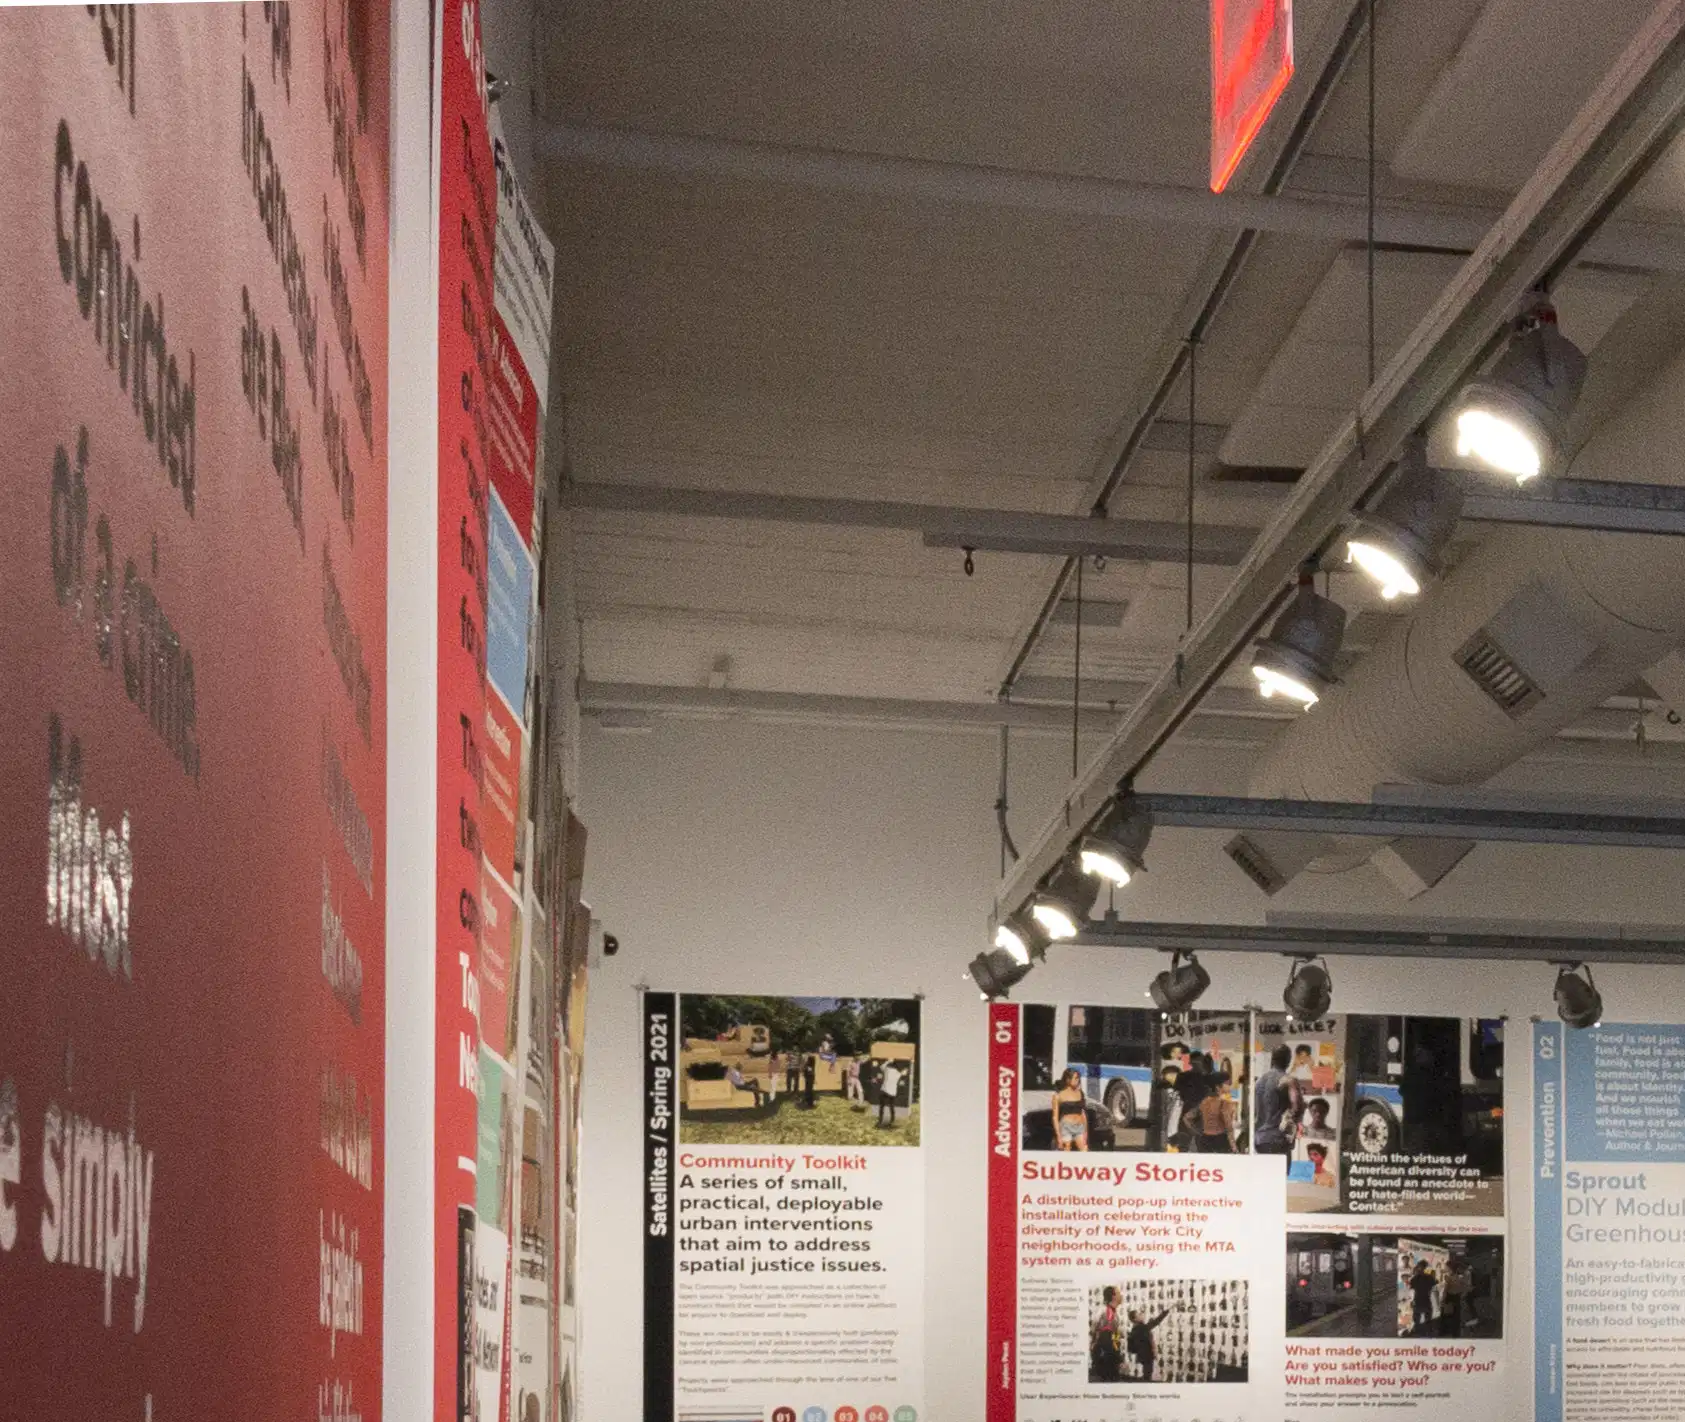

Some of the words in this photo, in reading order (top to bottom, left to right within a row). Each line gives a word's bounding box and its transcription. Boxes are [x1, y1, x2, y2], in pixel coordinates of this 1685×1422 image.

[54, 118, 196, 518] convicted
[51, 424, 89, 618] of
[96, 512, 113, 668] a
[121, 531, 200, 783] crime.
[47, 712, 133, 979] Most
[651, 1014, 667, 1062] 2021
[996, 1021, 1011, 1043] 01
[1539, 1034, 1554, 1059] 02
[651, 1066, 672, 1130] Spring
[995, 1065, 1015, 1158] Advocacy
[650, 1133, 668, 1144] /
[1539, 1081, 1554, 1177] Prevention
[680, 1153, 796, 1172] Community
[800, 1154, 869, 1170] Toolkit
[1022, 1160, 1128, 1185] Subway
[1134, 1162, 1226, 1182] Stories
[41, 1040, 154, 1331] simply
[651, 1146, 666, 1236] Satellites
[679, 1174, 695, 1188] A
[700, 1173, 759, 1189] series
[763, 1174, 785, 1189] of
[788, 1175, 848, 1192] small,
[1566, 1171, 1647, 1194] Sprout
[680, 1194, 770, 1212] practical,
[775, 1195, 884, 1214] deployable
[1021, 1193, 1032, 1204] A
[1036, 1193, 1113, 1206] distributed
[1117, 1197, 1168, 1209] pop-up
[1170, 1195, 1244, 1208] interactive
[1567, 1197, 1606, 1215] DIY
[679, 1215, 736, 1230] urban
[743, 1215, 874, 1231] interventions
[1022, 1208, 1099, 1220] installation
[1102, 1210, 1182, 1224] celebrating
[1185, 1211, 1209, 1222] the
[1020, 1223, 1082, 1238] diversity
[1085, 1224, 1101, 1236] of
[1104, 1225, 1136, 1236] New
[1138, 1225, 1172, 1236] York
[1175, 1225, 1204, 1239] City
[678, 1236, 720, 1251] that
[725, 1235, 762, 1251] aim
[767, 1238, 788, 1251] to
[793, 1236, 871, 1251] address
[1020, 1238, 1131, 1253] neighborhoods,
[1135, 1239, 1174, 1254] using
[1176, 1240, 1201, 1252] the
[1204, 1240, 1236, 1251] MTA
[679, 1256, 744, 1275] spatial
[748, 1256, 816, 1275] justice
[821, 1256, 886, 1272] issues.
[1021, 1255, 1072, 1268] system
[1075, 1257, 1092, 1266] as
[1095, 1257, 1104, 1266] a
[1107, 1255, 1159, 1269] gallery.
[1284, 1344, 1322, 1356] What
[1324, 1345, 1362, 1356] made
[1365, 1347, 1390, 1358] you
[1393, 1344, 1429, 1356] smile
[1431, 1345, 1476, 1359] today?
[1284, 1360, 1308, 1370] Are
[1312, 1362, 1337, 1373] you
[1340, 1359, 1404, 1371] satisfied?
[1406, 1360, 1438, 1371] Who
[1441, 1362, 1462, 1371] are
[1464, 1360, 1498, 1374] you?
[1284, 1374, 1321, 1386] What
[1324, 1374, 1368, 1386] makes
[1370, 1376, 1396, 1388] you
[1398, 1374, 1430, 1388] you?
